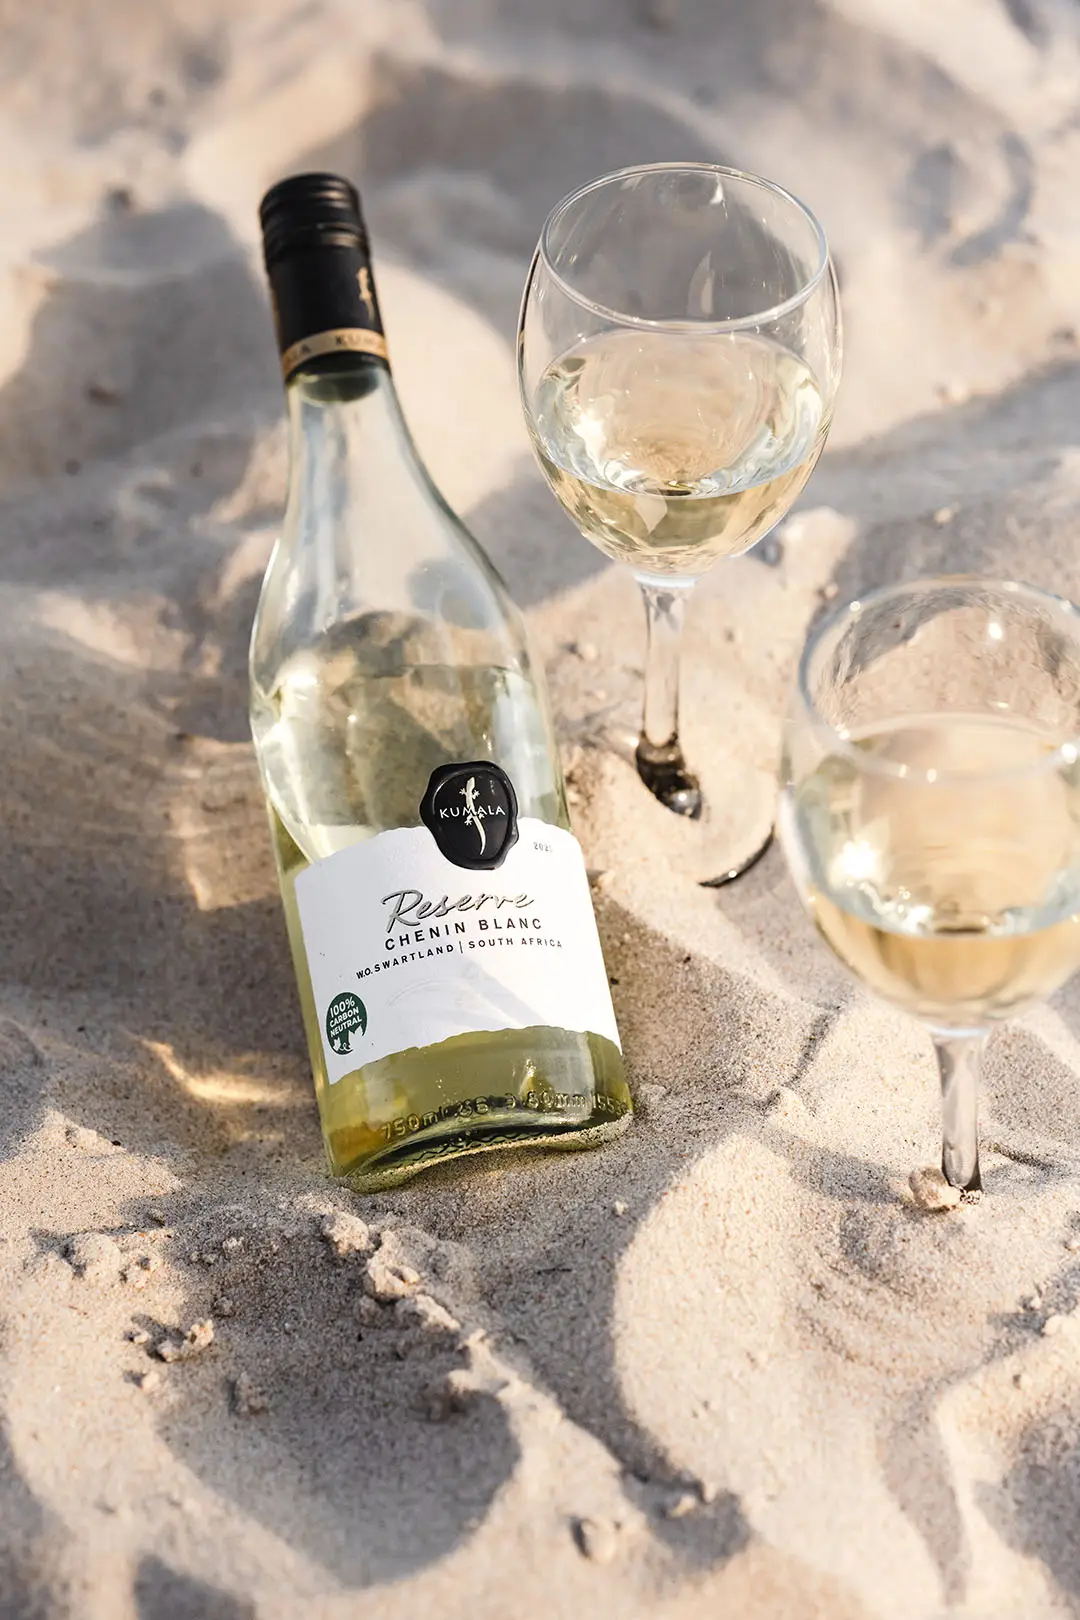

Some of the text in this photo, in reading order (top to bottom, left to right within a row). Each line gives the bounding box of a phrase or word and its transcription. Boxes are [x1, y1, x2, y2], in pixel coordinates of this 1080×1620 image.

[440, 805, 506, 819] KUMALA
[381, 889, 534, 933] Reserve
[385, 918, 542, 951] CHENIN BLANC
[468, 938, 514, 949] SOUTH
[521, 937, 562, 950] AFRICA
[329, 1006, 359, 1028] CARBON
[330, 996, 355, 1018] 100%
[330, 1015, 362, 1038] NEUTRAL
